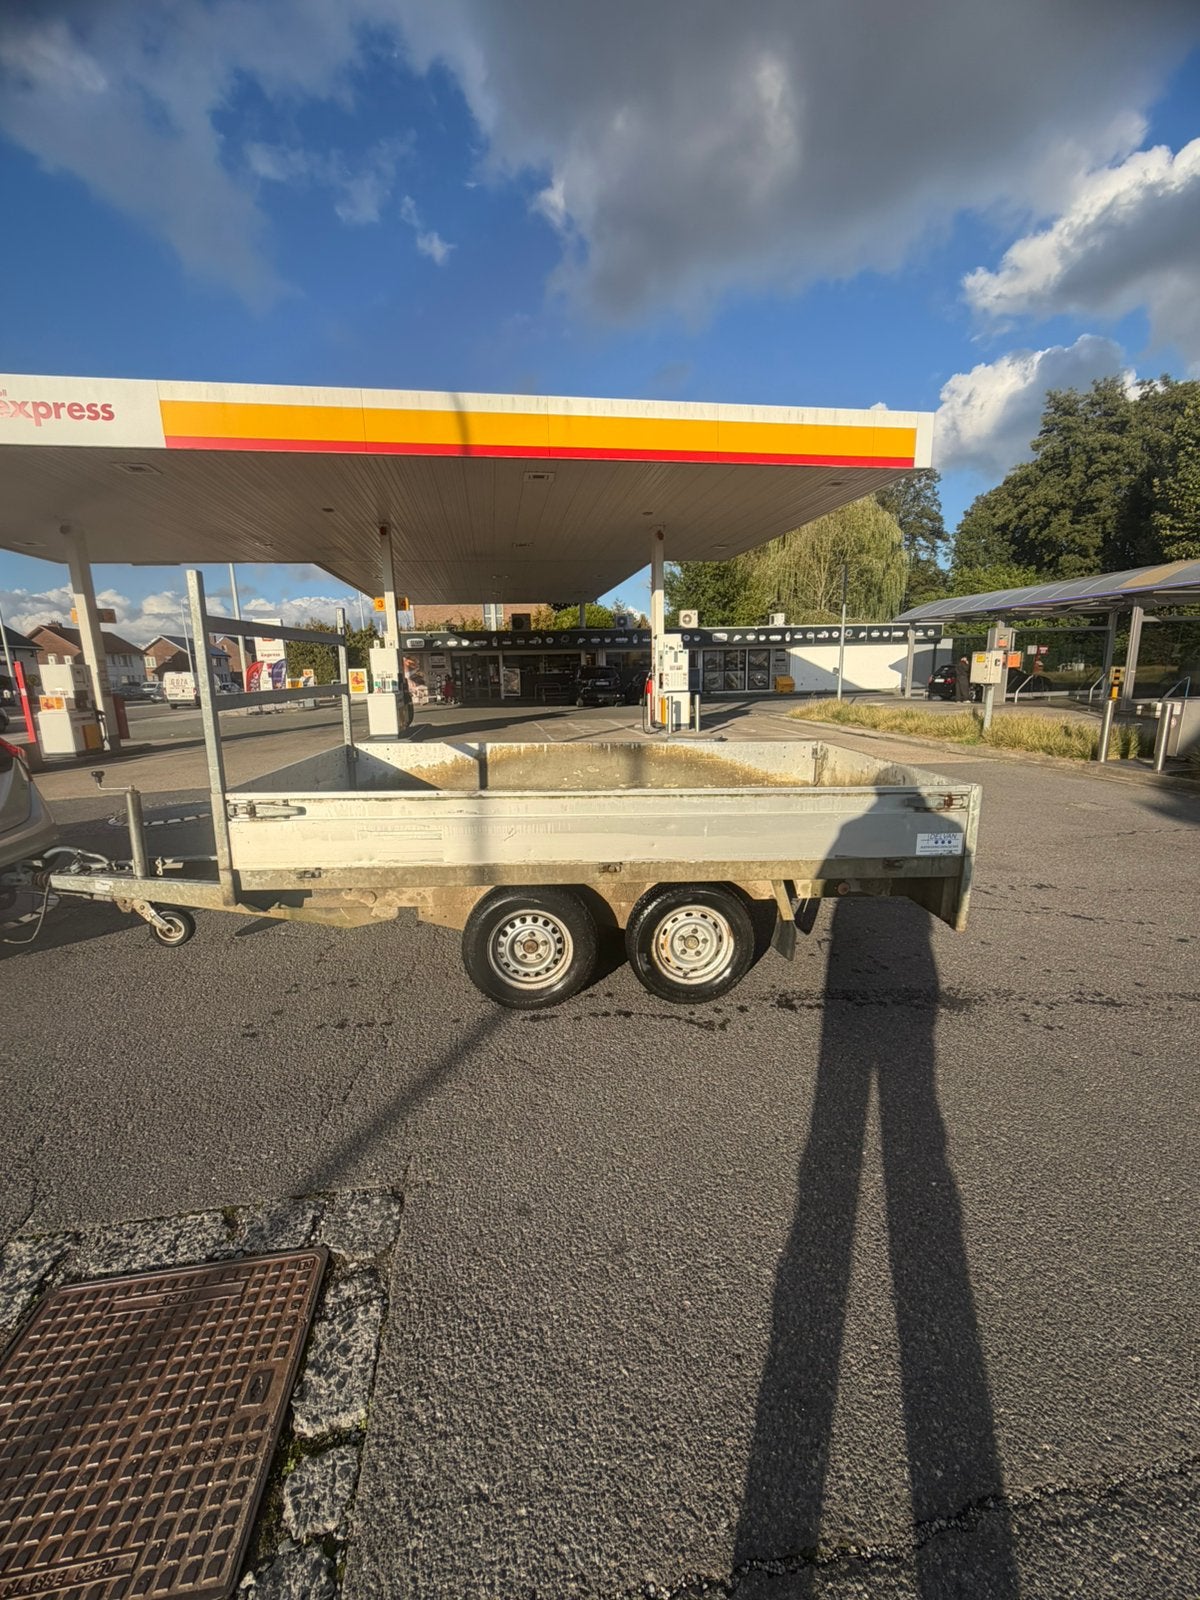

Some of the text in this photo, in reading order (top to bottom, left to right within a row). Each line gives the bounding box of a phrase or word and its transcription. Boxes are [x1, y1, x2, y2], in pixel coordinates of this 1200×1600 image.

[377, 600, 384, 608] 3
[2, 1557, 119, 1598] CLASSE C250
